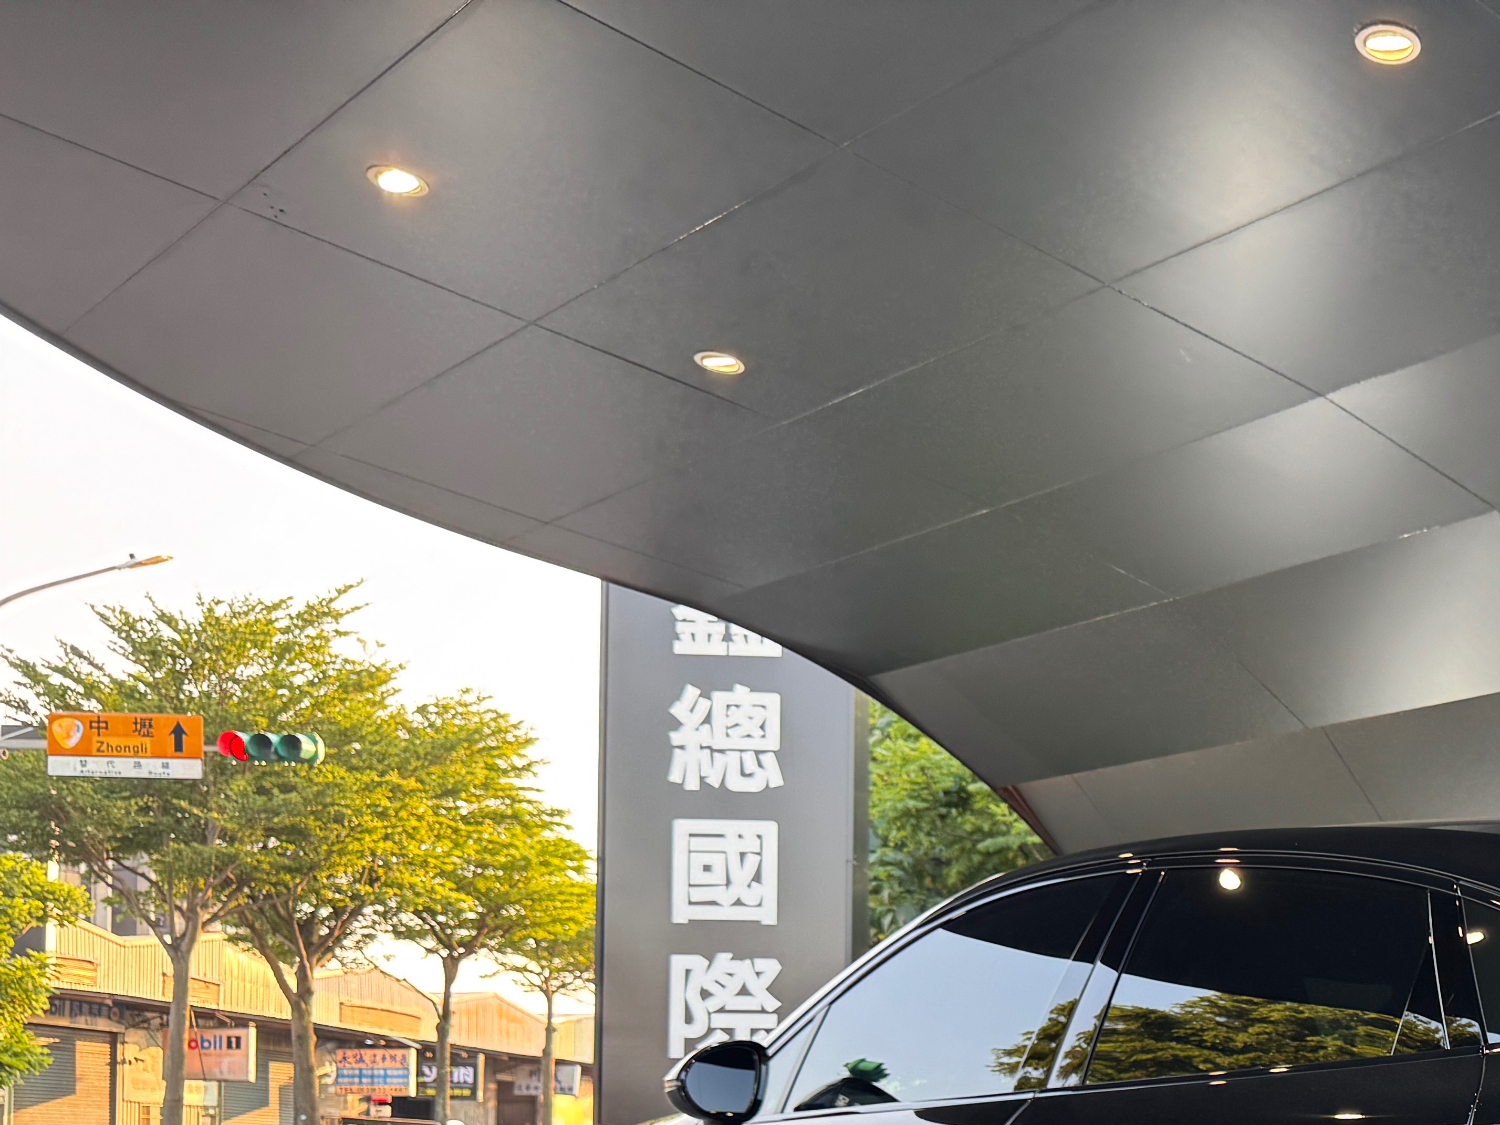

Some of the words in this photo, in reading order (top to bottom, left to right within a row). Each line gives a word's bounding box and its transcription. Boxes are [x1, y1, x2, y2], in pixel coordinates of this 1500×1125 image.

[89, 715, 155, 738] 中壢
[96, 741, 148, 756] Zhongli
[188, 1034, 223, 1051] obil
